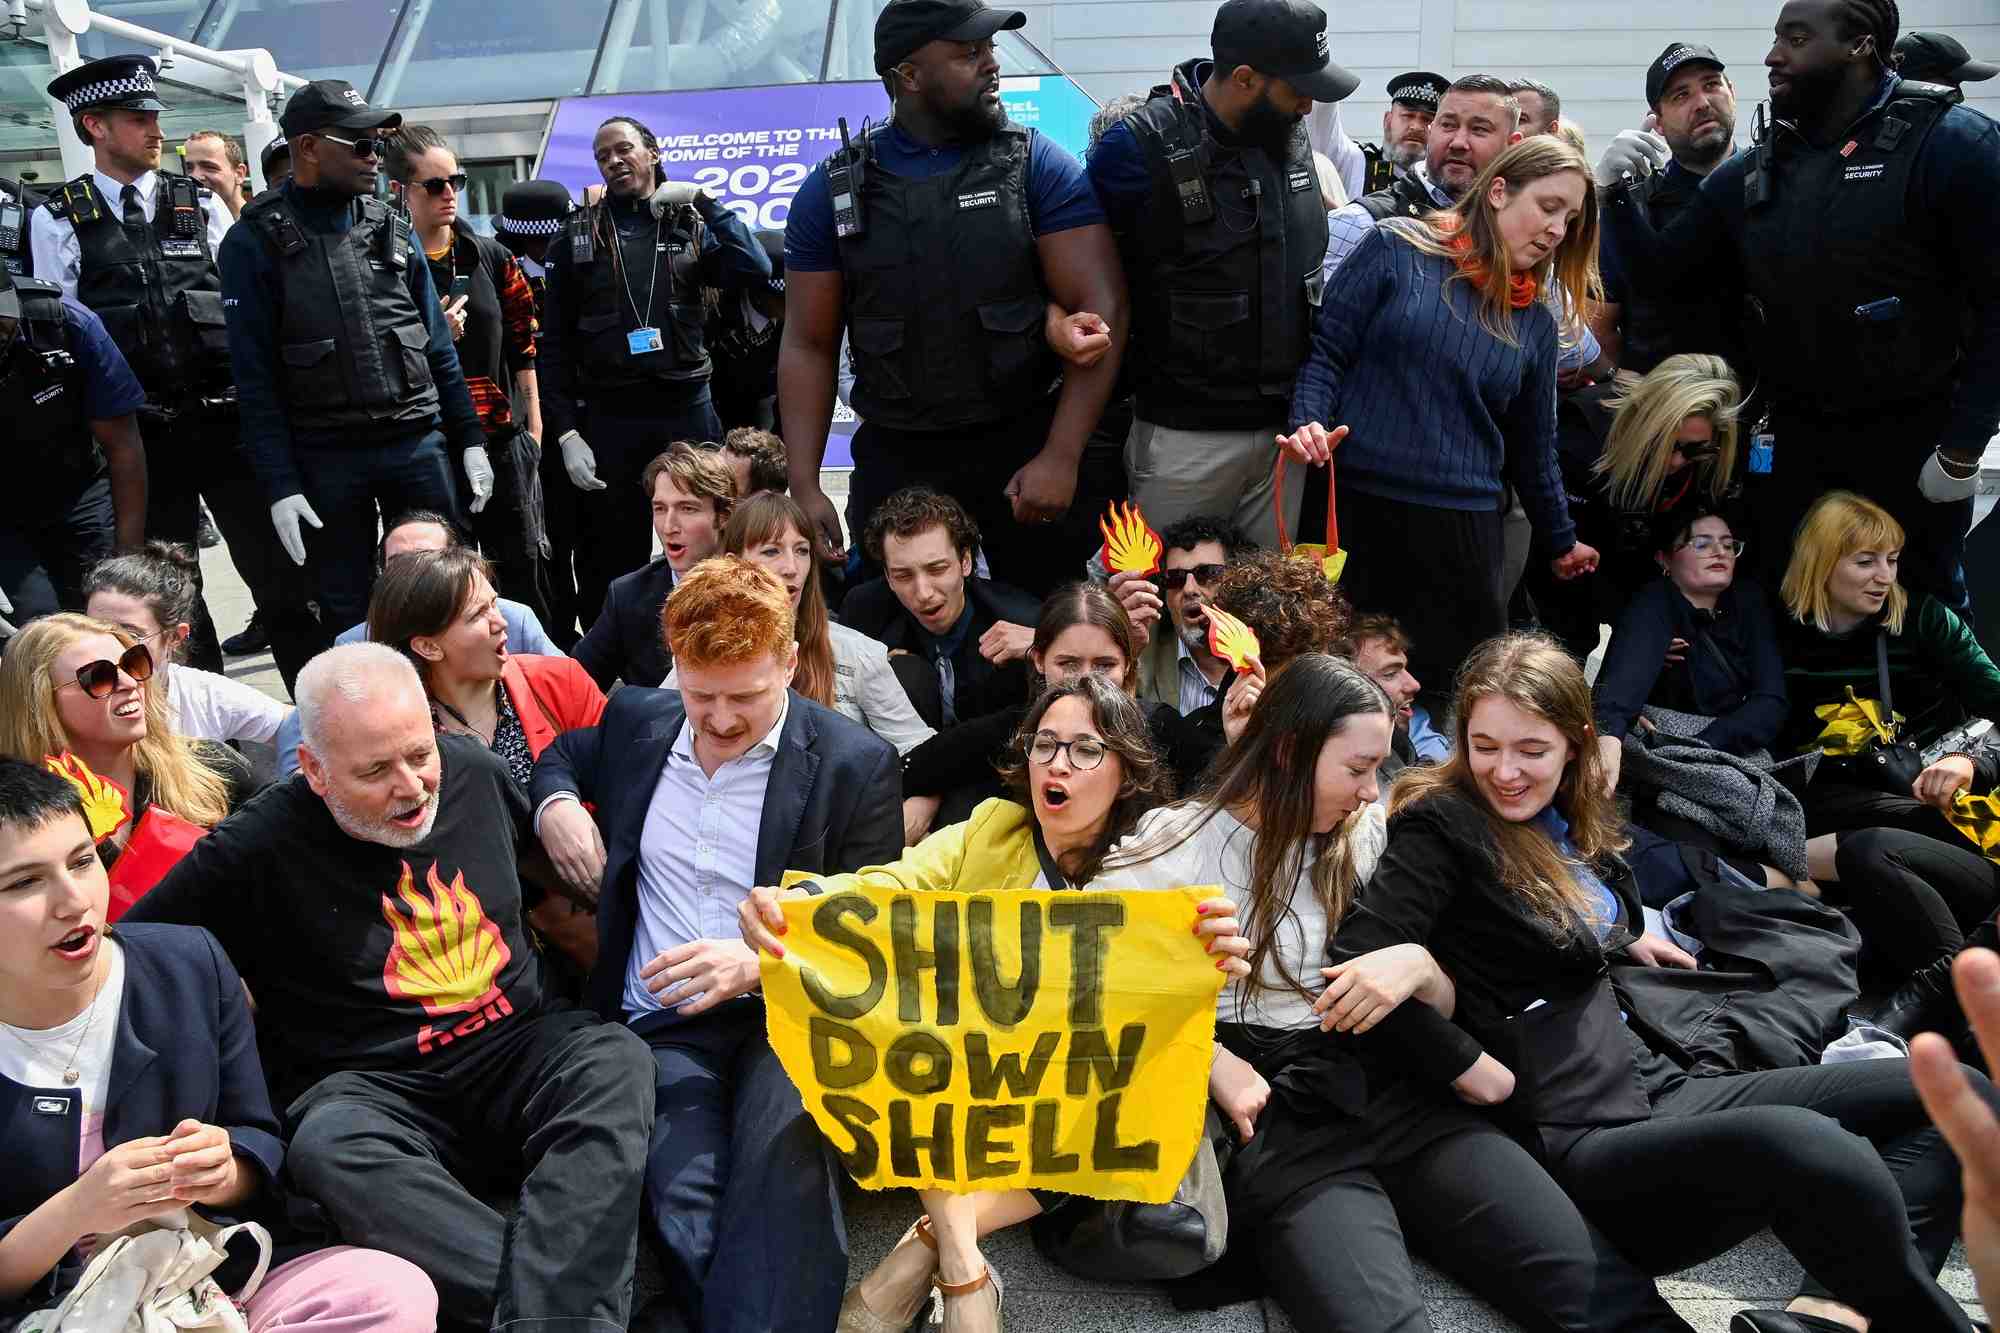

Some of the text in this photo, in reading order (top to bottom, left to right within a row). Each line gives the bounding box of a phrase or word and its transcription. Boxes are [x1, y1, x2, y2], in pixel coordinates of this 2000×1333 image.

[656, 131, 770, 149] WELCOME
[772, 129, 802, 142] TO
[659, 143, 801, 163] HOME OF THE
[693, 162, 824, 197] 202
[1844, 170, 1883, 180] SECURITY
[959, 196, 997, 208] SECURITY
[800, 891, 1127, 1031] SHUT
[808, 1016, 1146, 1100] DOWN
[820, 1091, 1159, 1182] SHELL
